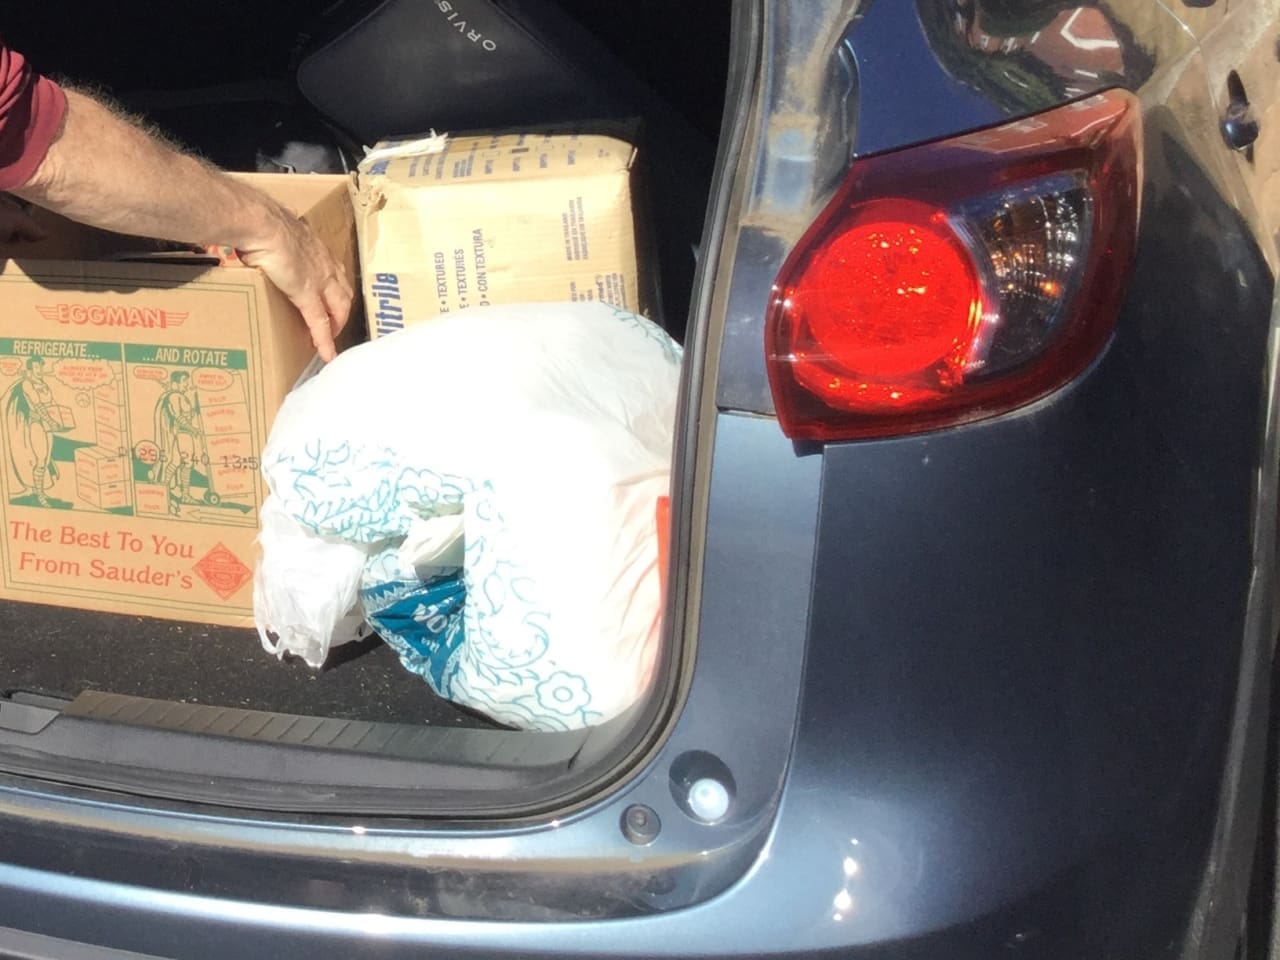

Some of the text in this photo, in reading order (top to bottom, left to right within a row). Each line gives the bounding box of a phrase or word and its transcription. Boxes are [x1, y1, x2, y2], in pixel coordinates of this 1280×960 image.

[438, 0, 497, 52] ORVIS
[472, 227, 486, 270] TEXTURA
[433, 251, 448, 299] TEXTURED
[476, 271, 489, 292] CON
[56, 303, 167, 329] EGGMAN
[12, 339, 101, 359] REFRIGERATE...
[183, 349, 229, 366] ROTATE
[9, 520, 195, 559] The Best To You
[18, 551, 81, 577] From
[88, 559, 194, 590] Sauder's
